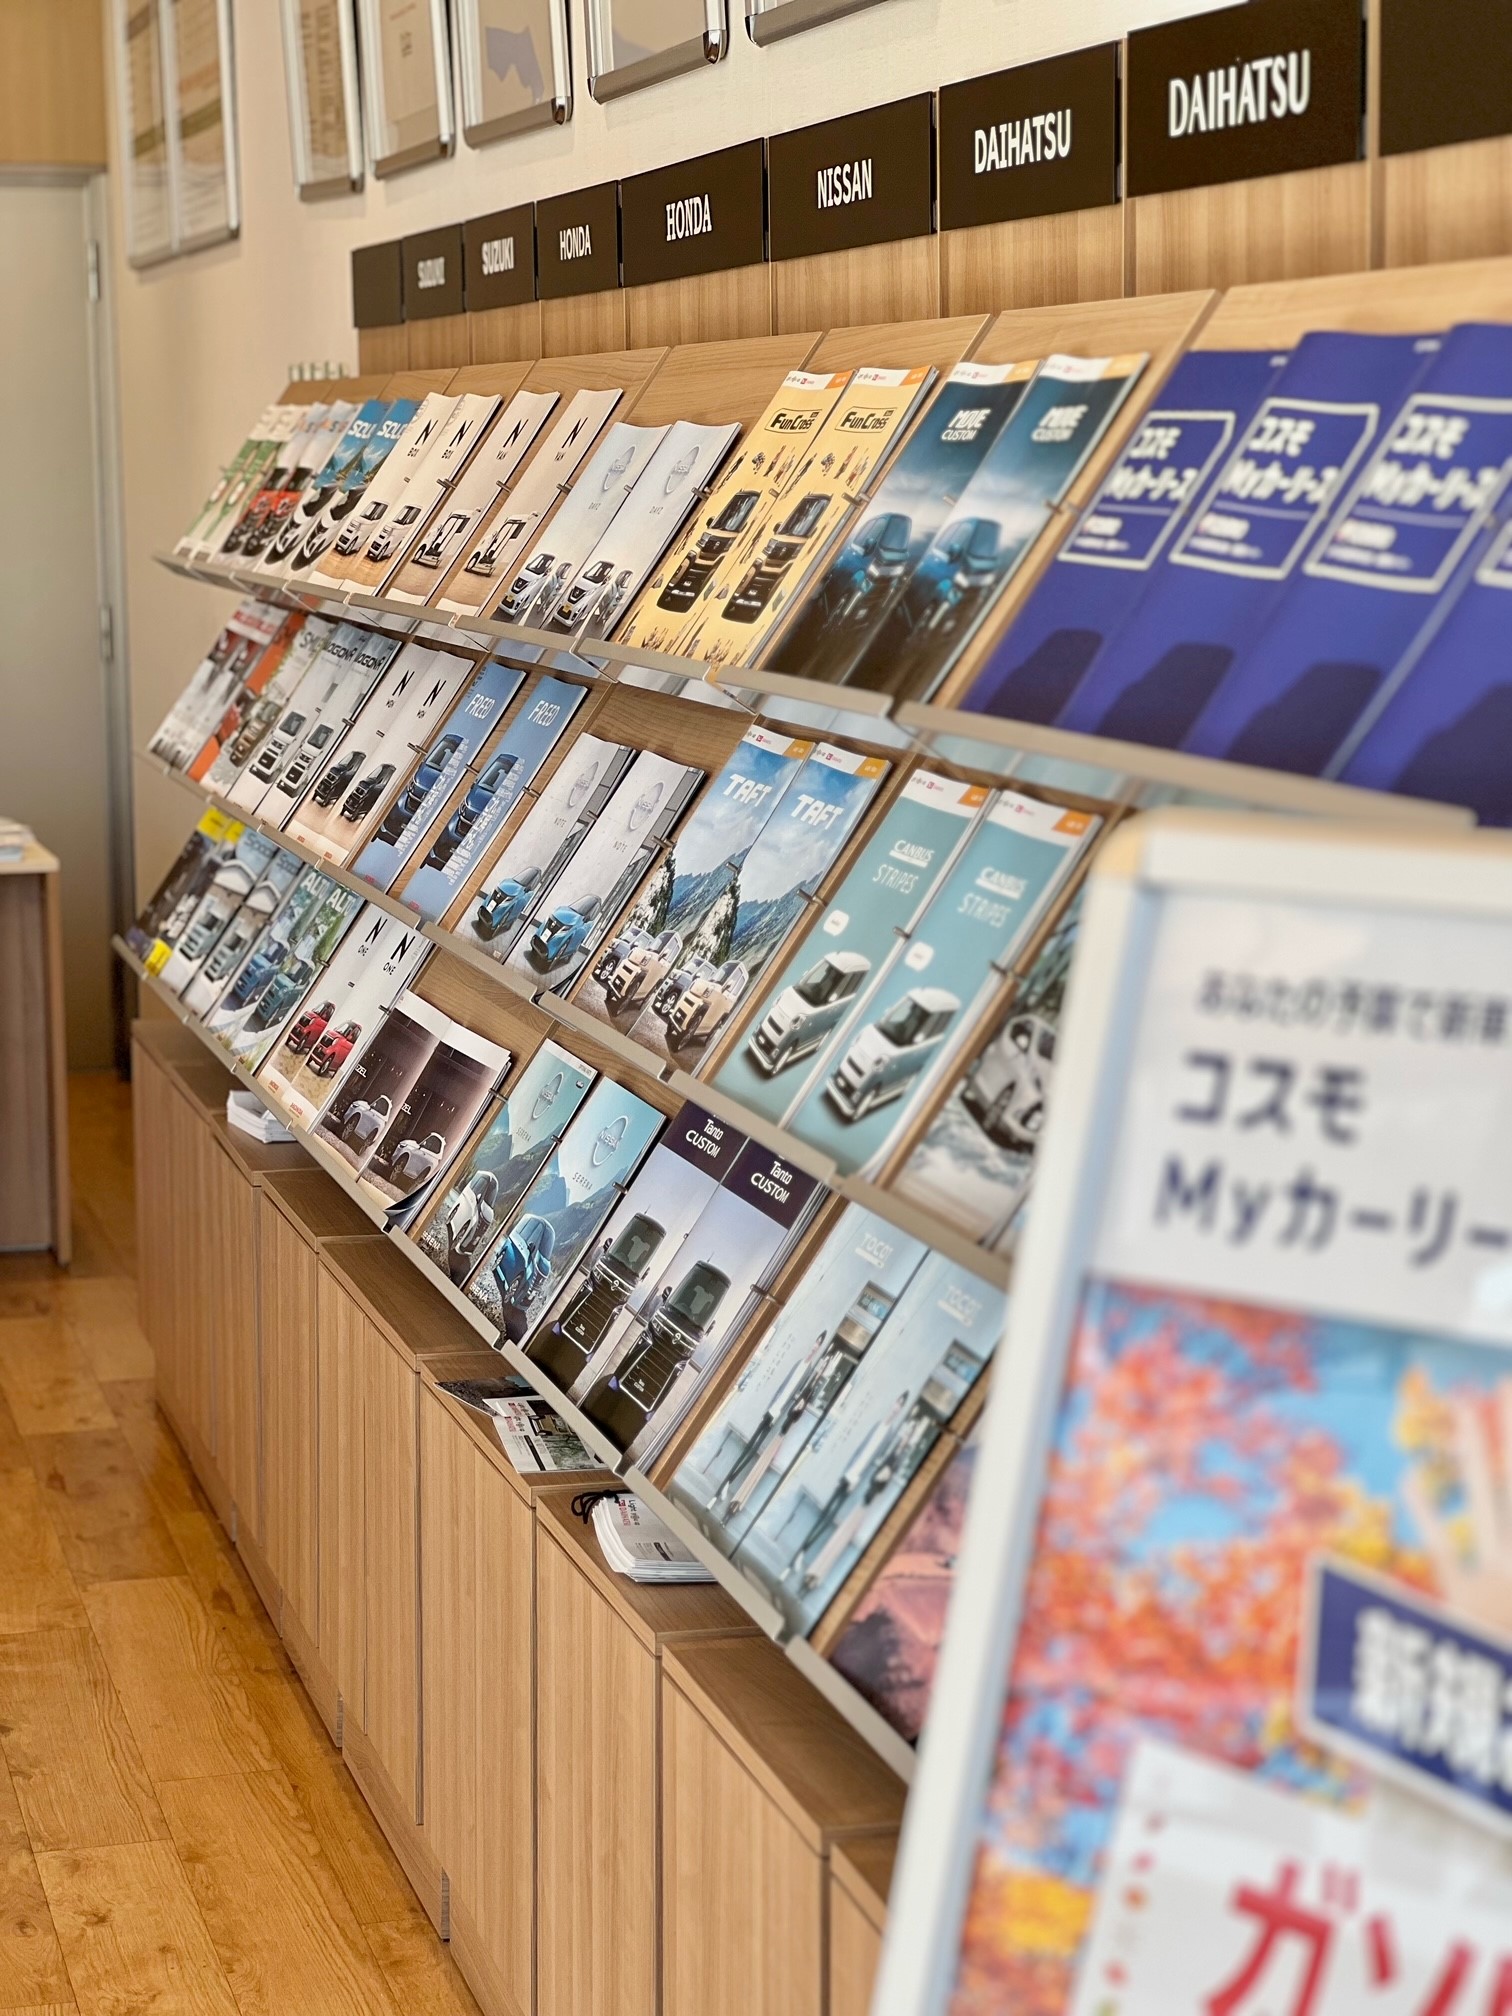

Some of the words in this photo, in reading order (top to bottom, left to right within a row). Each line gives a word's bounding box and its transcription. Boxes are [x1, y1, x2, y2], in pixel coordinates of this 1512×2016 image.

[1168, 49, 1312, 138] DAIHATSU
[973, 108, 1073, 174] DAIHATSU
[816, 158, 873, 209] NISSAN
[664, 193, 714, 242] HONDA
[481, 236, 515, 275] SUZUKI
[558, 224, 592, 261] HONDA
[415, 419, 438, 446] N
[561, 416, 588, 449] N
[948, 407, 992, 429] MOVE
[449, 420, 474, 447] N
[503, 418, 529, 449] N
[941, 428, 978, 442] CUSTOM
[391, 670, 415, 697] N
[423, 679, 447, 707] N
[464, 693, 496, 720] FREED
[527, 699, 561, 727] FREED
[722, 773, 773, 807] TAFT
[790, 793, 845, 830] TAFT
[612, 840, 628, 853] NOTE
[893, 839, 935, 863] CANBUS
[872, 864, 919, 895] STRIPES
[364, 915, 388, 945] N
[390, 931, 416, 964] N
[382, 961, 397, 976] ONE
[1173, 1048, 1367, 1147] コスモ
[515, 1126, 532, 1142] SERENA
[685, 1129, 721, 1159] CUSTOM
[703, 1118, 724, 1142] Tanto
[572, 1171, 593, 1191] SERENA
[769, 1160, 793, 1185] Tanto
[750, 1172, 790, 1205] CUSTOM
